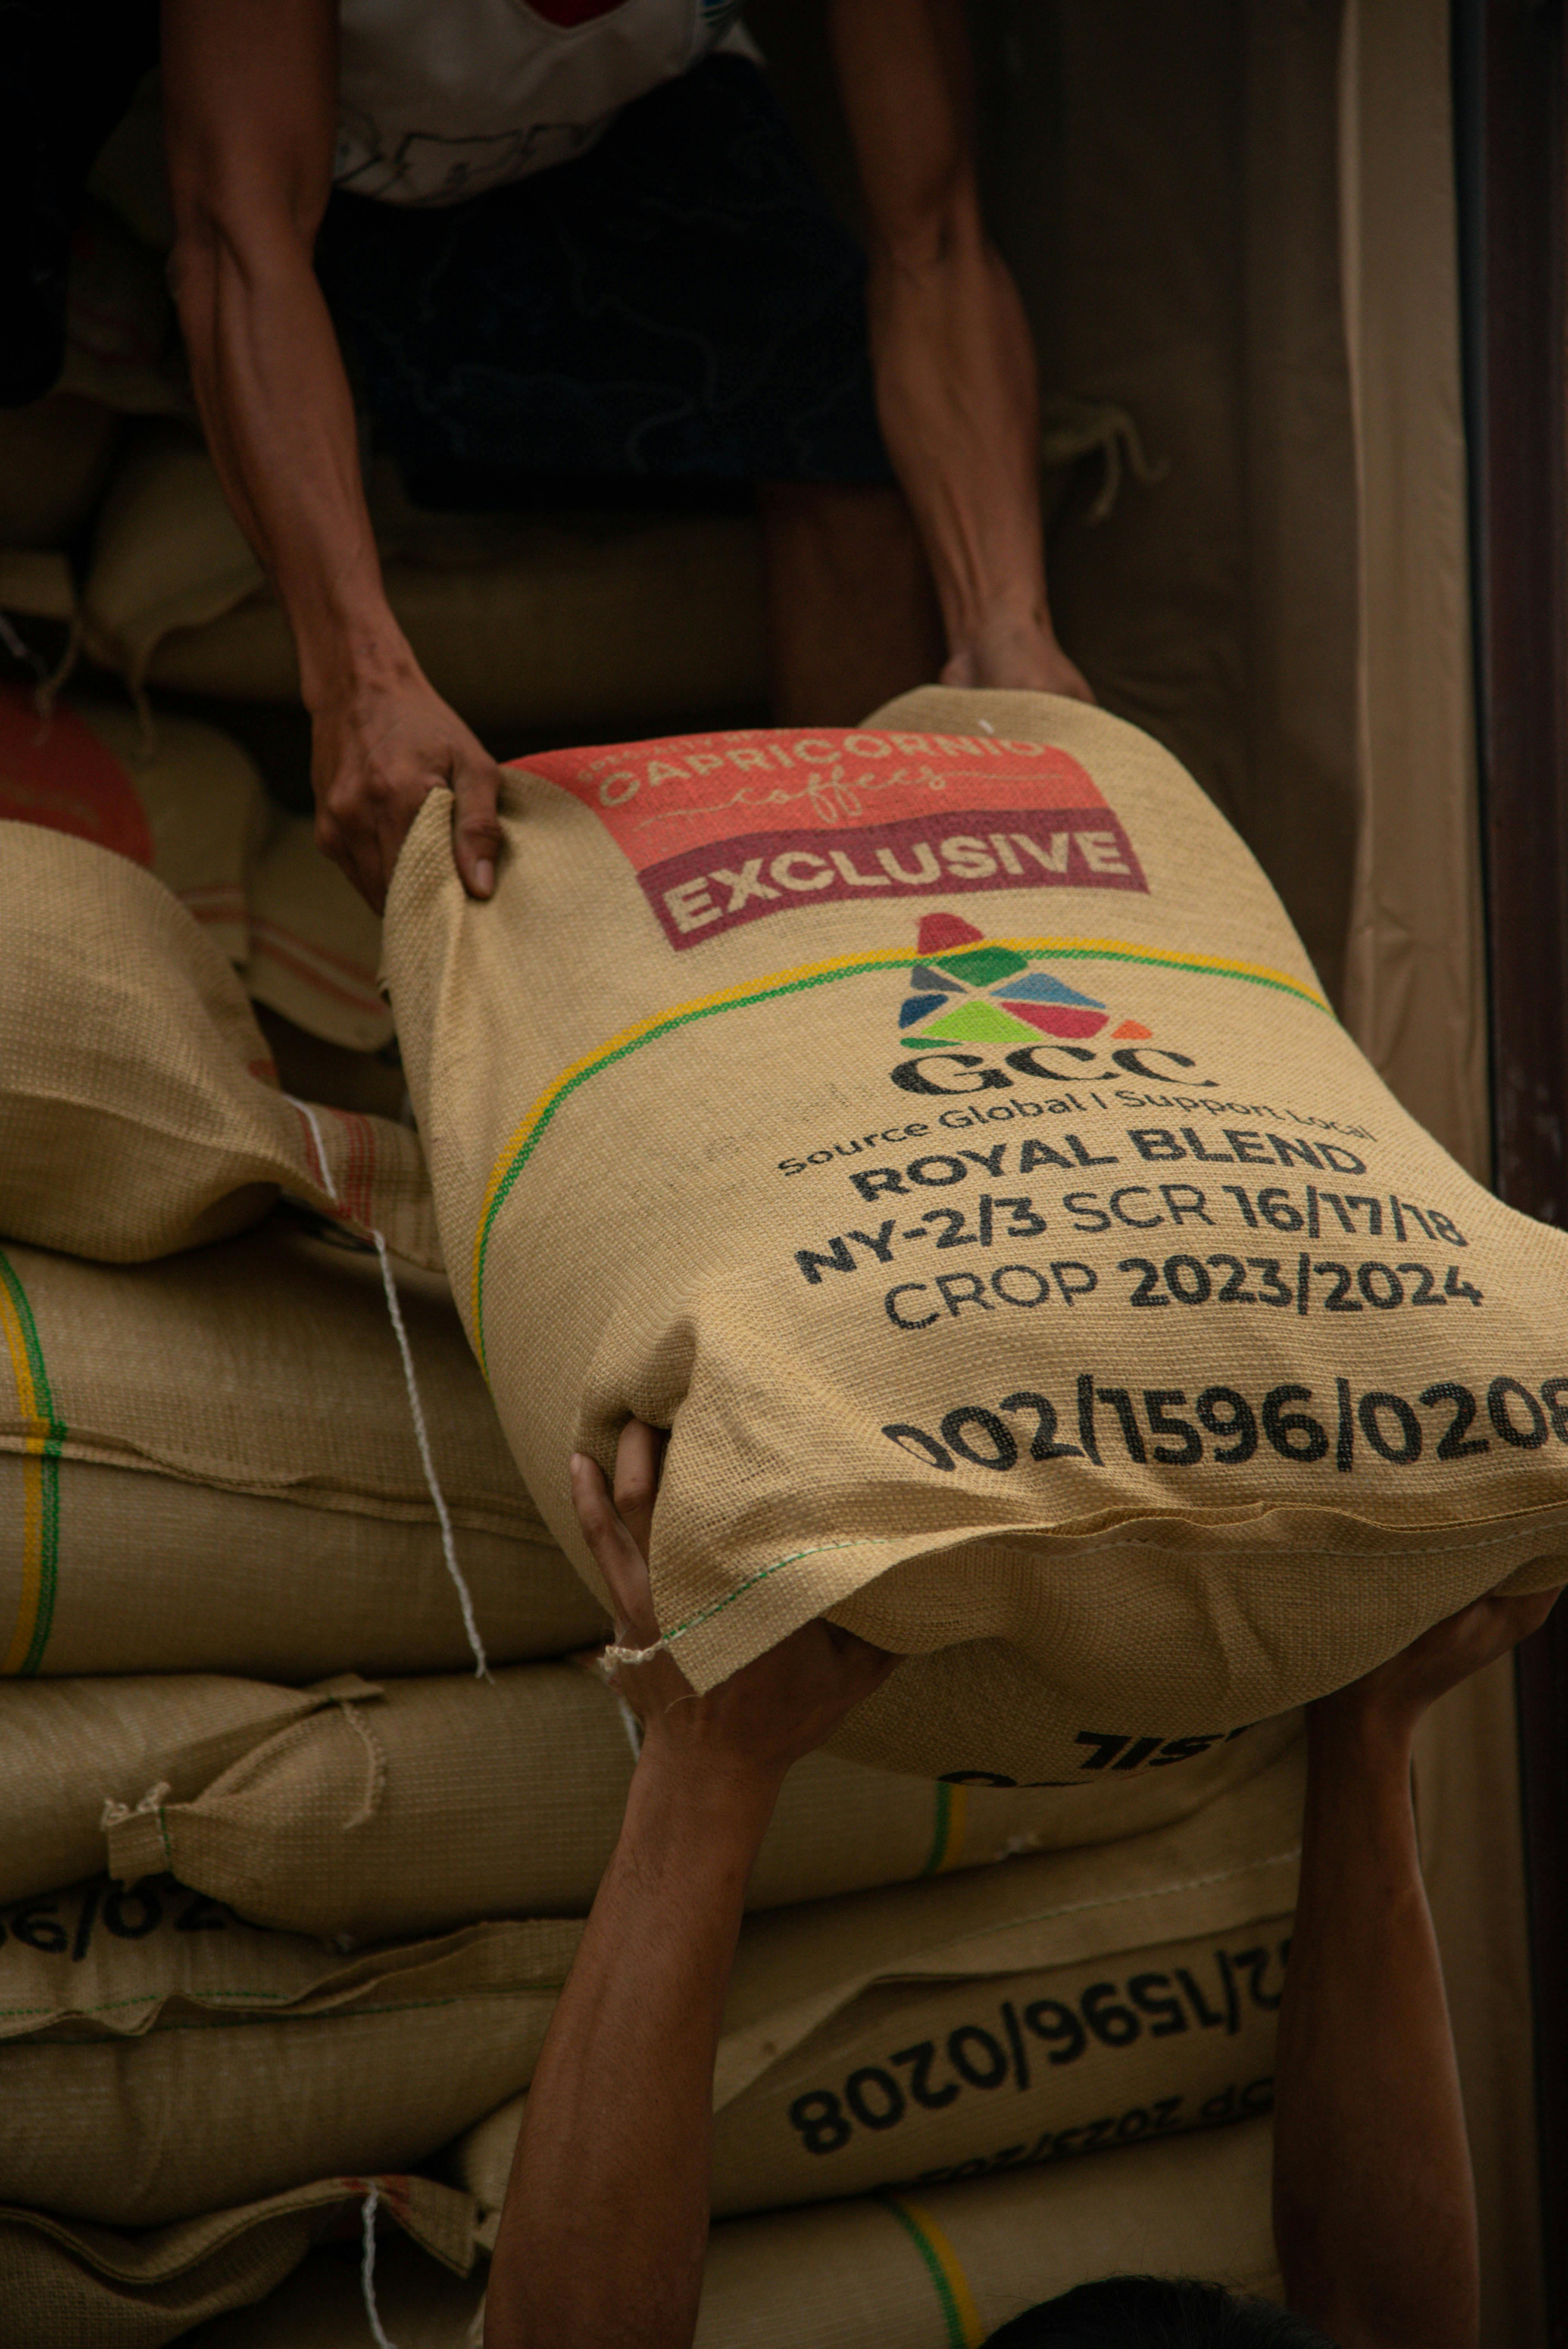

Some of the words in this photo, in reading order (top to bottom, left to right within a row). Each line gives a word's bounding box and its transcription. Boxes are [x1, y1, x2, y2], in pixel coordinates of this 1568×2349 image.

[599, 733, 1047, 807] CAPRICORNIO
[662, 830, 1131, 935] EXCLUSIVE
[891, 1045, 1220, 1096] GCC
[777, 1122, 932, 1177] Source
[938, 1093, 1087, 1129] Global
[1115, 1089, 1286, 1120] Support
[1285, 1109, 1377, 1142] Local
[849, 1133, 1119, 1202] ROYAL
[1127, 1127, 1367, 1175] BLEND
[794, 1194, 1047, 1285] NY-2/3
[1062, 1184, 1215, 1232] SCR
[1222, 1185, 1467, 1248] 16/17/18
[884, 1261, 1098, 1330] CROP
[1116, 1252, 1483, 1315] 2023/2024
[1074, 1723, 1249, 1771] SIL
[790, 1937, 1292, 2155] 2/1596/0208
